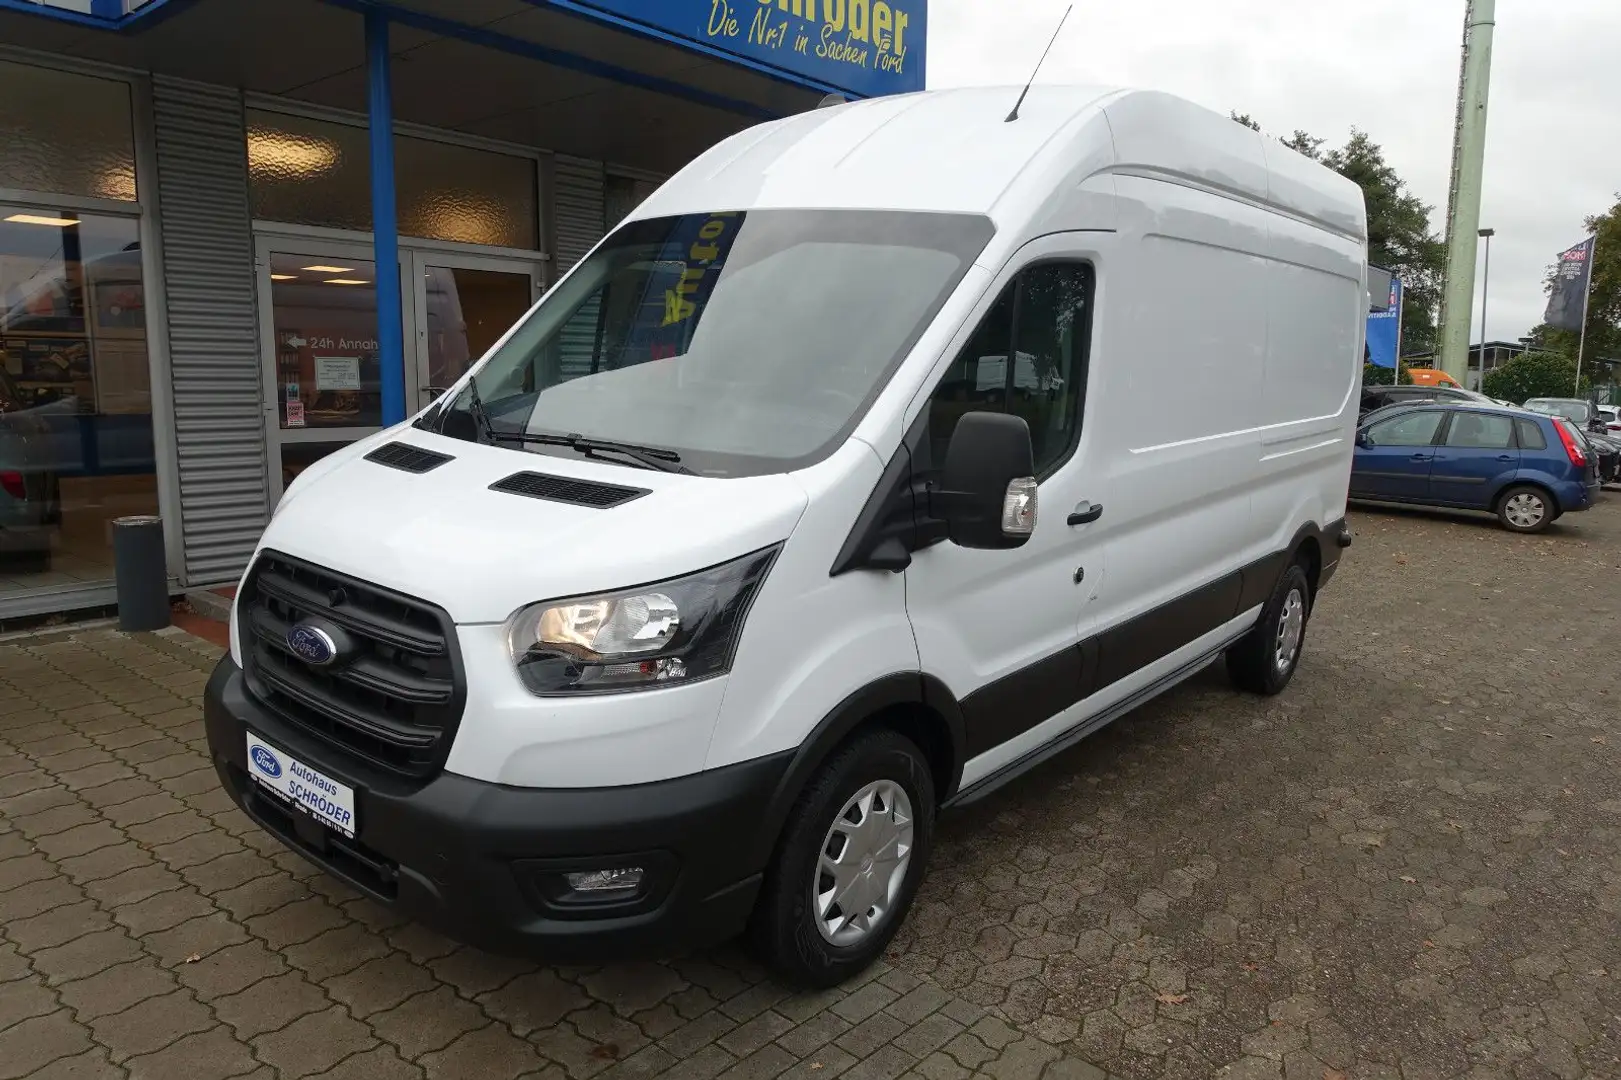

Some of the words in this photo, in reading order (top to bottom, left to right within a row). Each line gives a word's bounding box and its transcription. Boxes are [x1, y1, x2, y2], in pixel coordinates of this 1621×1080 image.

[707, 0, 740, 37] Die
[794, 25, 809, 56] in
[816, 23, 867, 68] Sachen
[874, 34, 907, 74] Ford
[310, 337, 335, 349] 24h
[338, 338, 379, 350] Annah
[292, 630, 321, 657] Ford
[289, 761, 338, 796] Autohaus
[288, 780, 351, 826] SCHRÖDER
